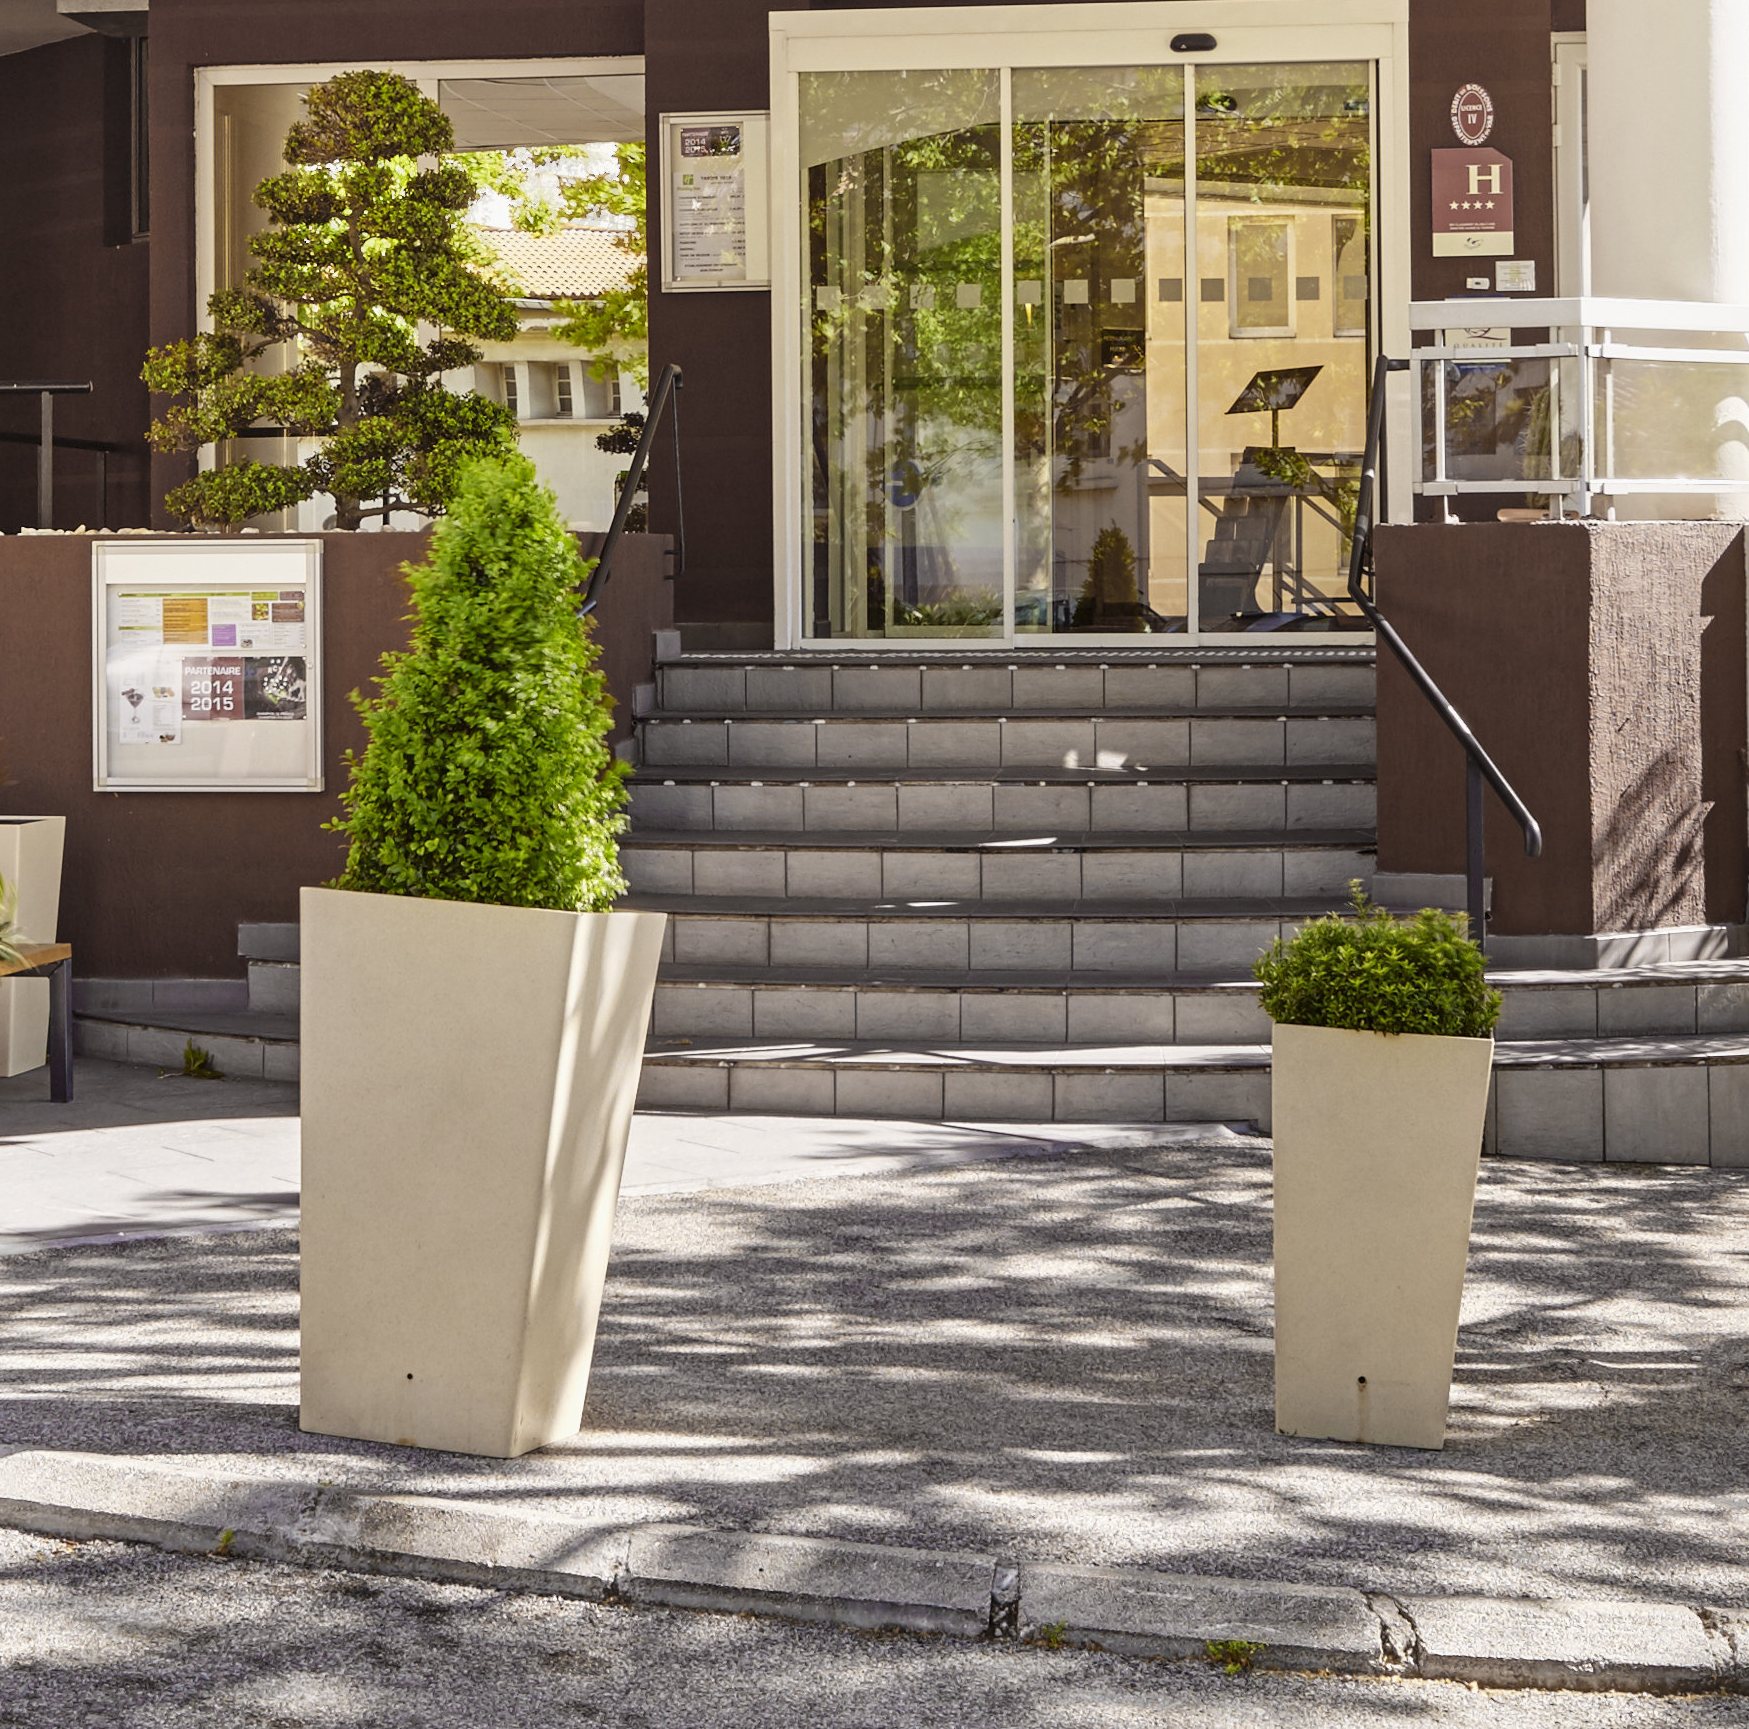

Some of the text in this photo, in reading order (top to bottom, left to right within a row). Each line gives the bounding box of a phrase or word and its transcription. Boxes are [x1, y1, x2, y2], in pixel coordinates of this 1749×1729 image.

[1467, 113, 1478, 125] IV
[1465, 164, 1504, 196] H
[184, 666, 241, 676] PARTENAIRE
[191, 680, 234, 695] 2014
[191, 697, 234, 711] 2015
